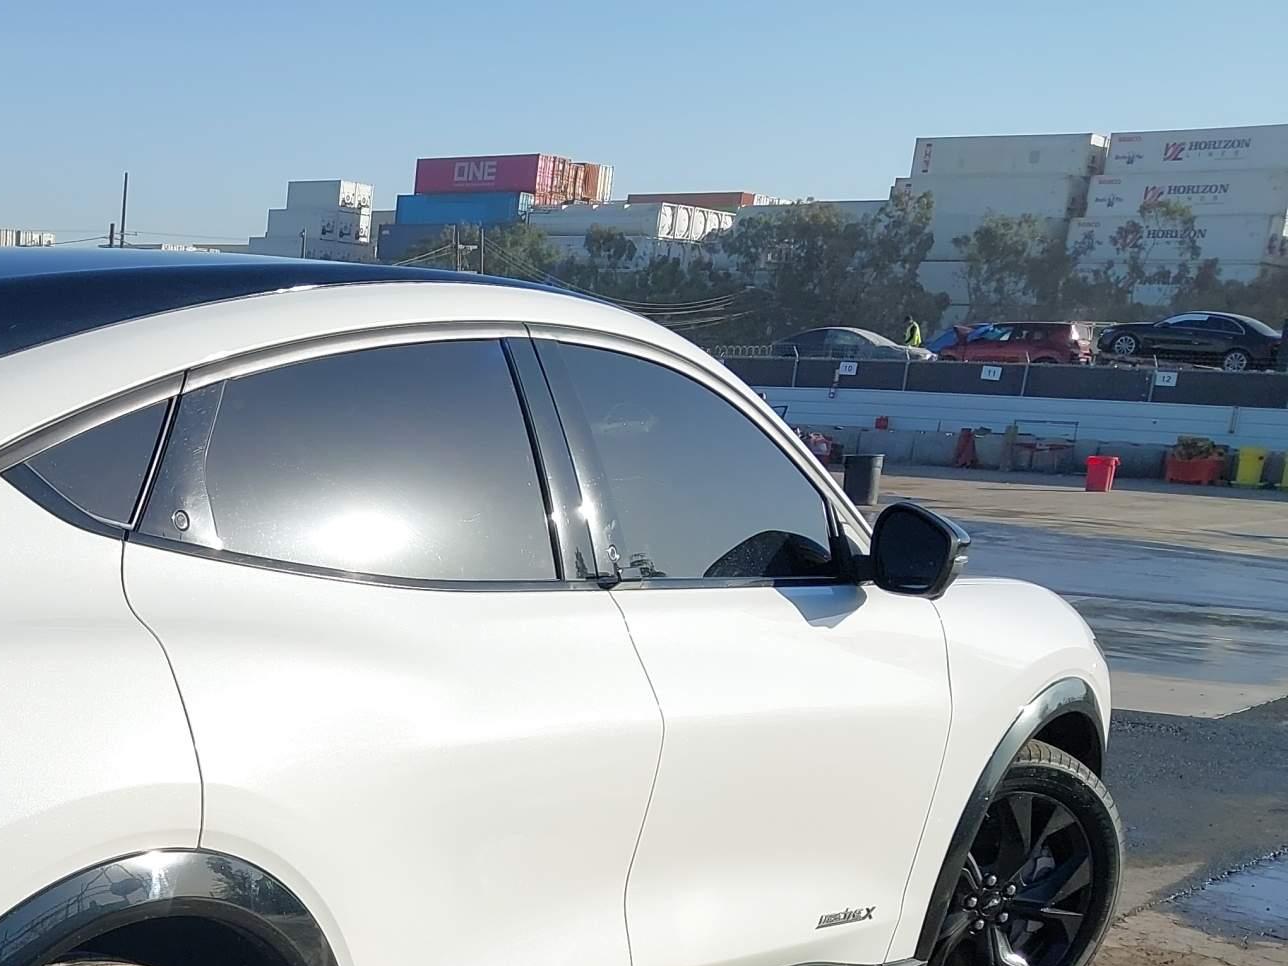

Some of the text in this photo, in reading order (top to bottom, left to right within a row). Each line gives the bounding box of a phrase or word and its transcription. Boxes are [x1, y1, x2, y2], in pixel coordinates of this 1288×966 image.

[1188, 138, 1252, 151] HORIZON
[454, 161, 497, 181] ONE
[1167, 183, 1230, 195] HORIZON
